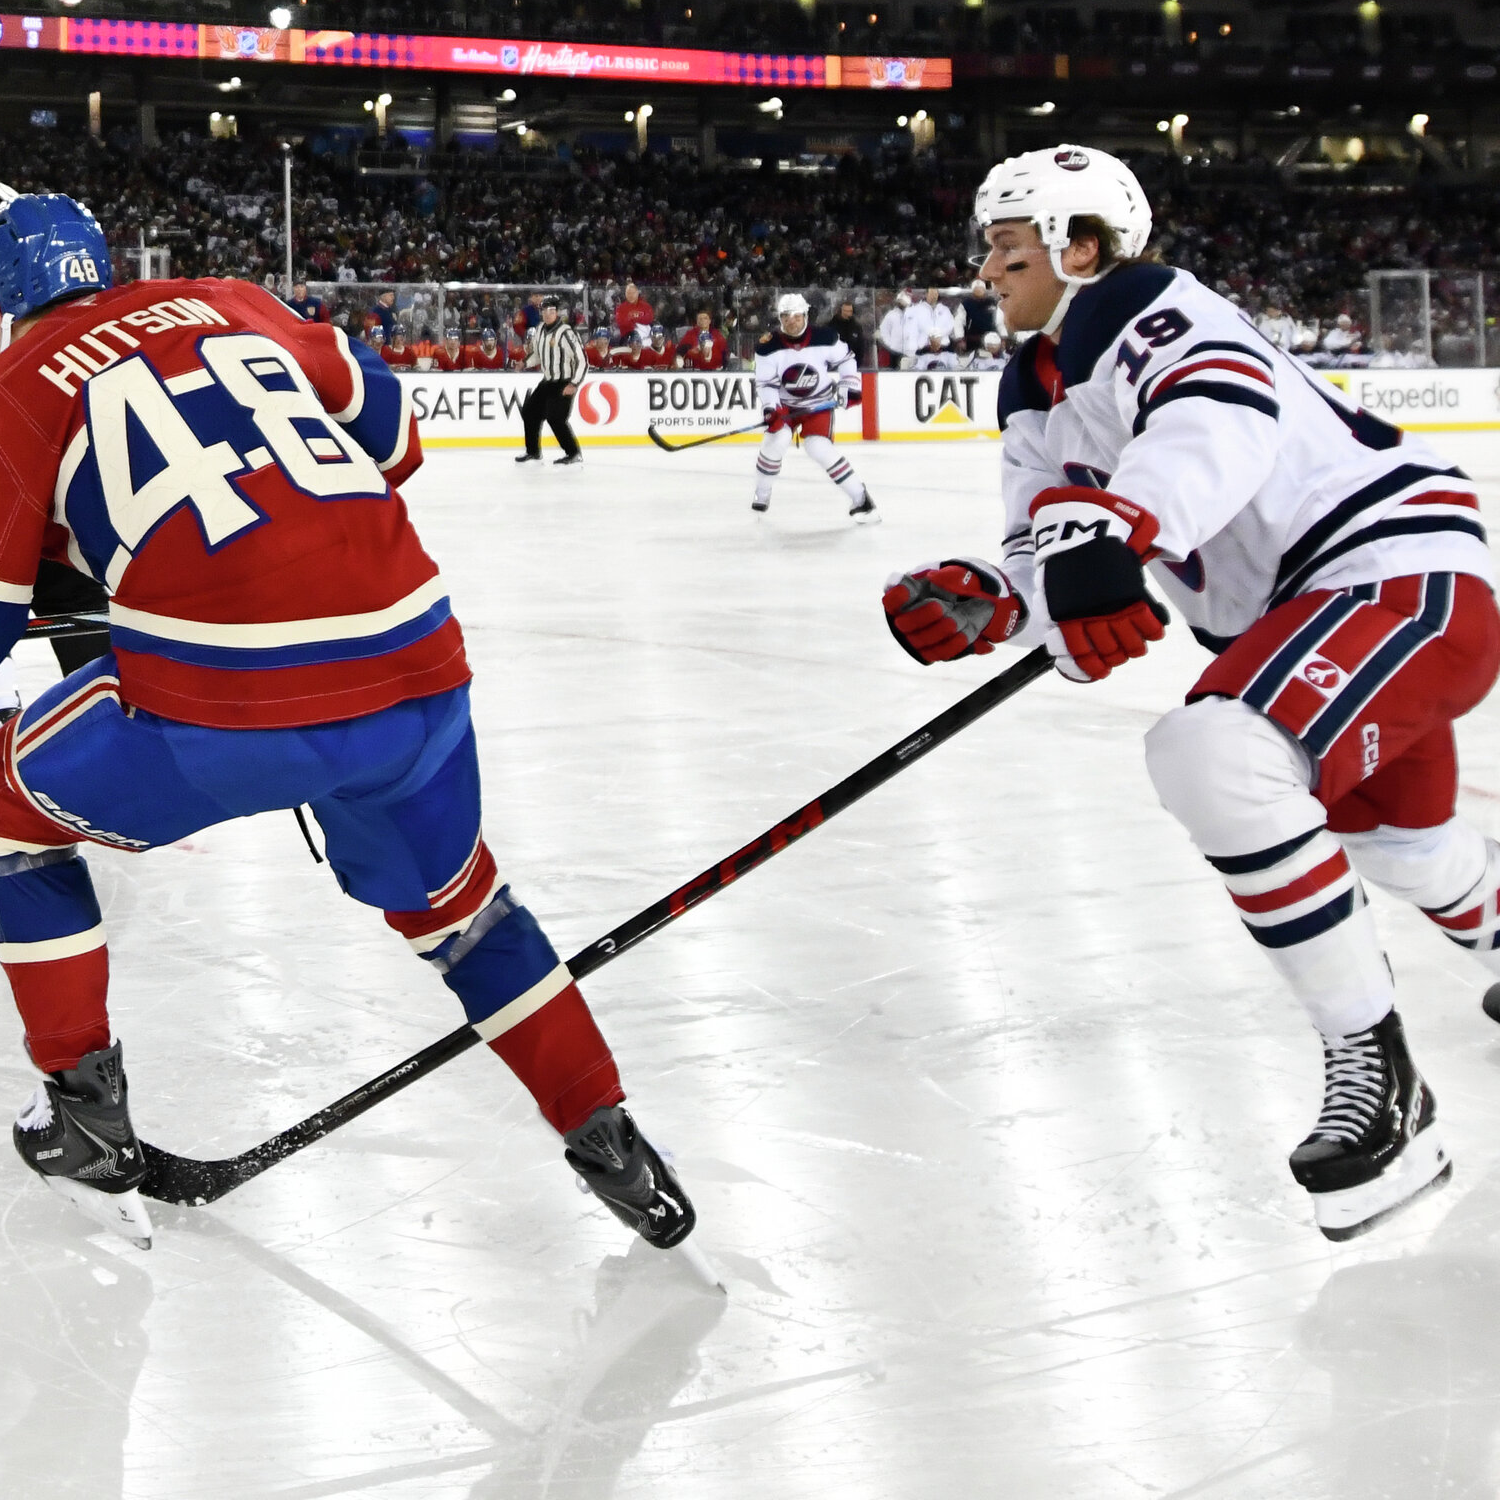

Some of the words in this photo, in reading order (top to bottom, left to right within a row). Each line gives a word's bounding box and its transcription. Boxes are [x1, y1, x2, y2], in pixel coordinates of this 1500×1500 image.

[520, 44, 594, 77] Heritage
[594, 54, 660, 71] CLASSIC
[68, 258, 100, 283] 48
[37, 297, 231, 398] HUTSON
[1114, 306, 1195, 386] 19
[915, 375, 980, 423] CAT
[1361, 382, 1460, 414] Expedia
[649, 417, 695, 427] SPORTS
[697, 417, 732, 427] DRINK
[83, 331, 390, 556] 48
[1004, 609, 1019, 637] CCM
[31, 790, 151, 848] BAUER
[668, 799, 825, 919] CCM
[36, 1147, 64, 1161] BAUER
